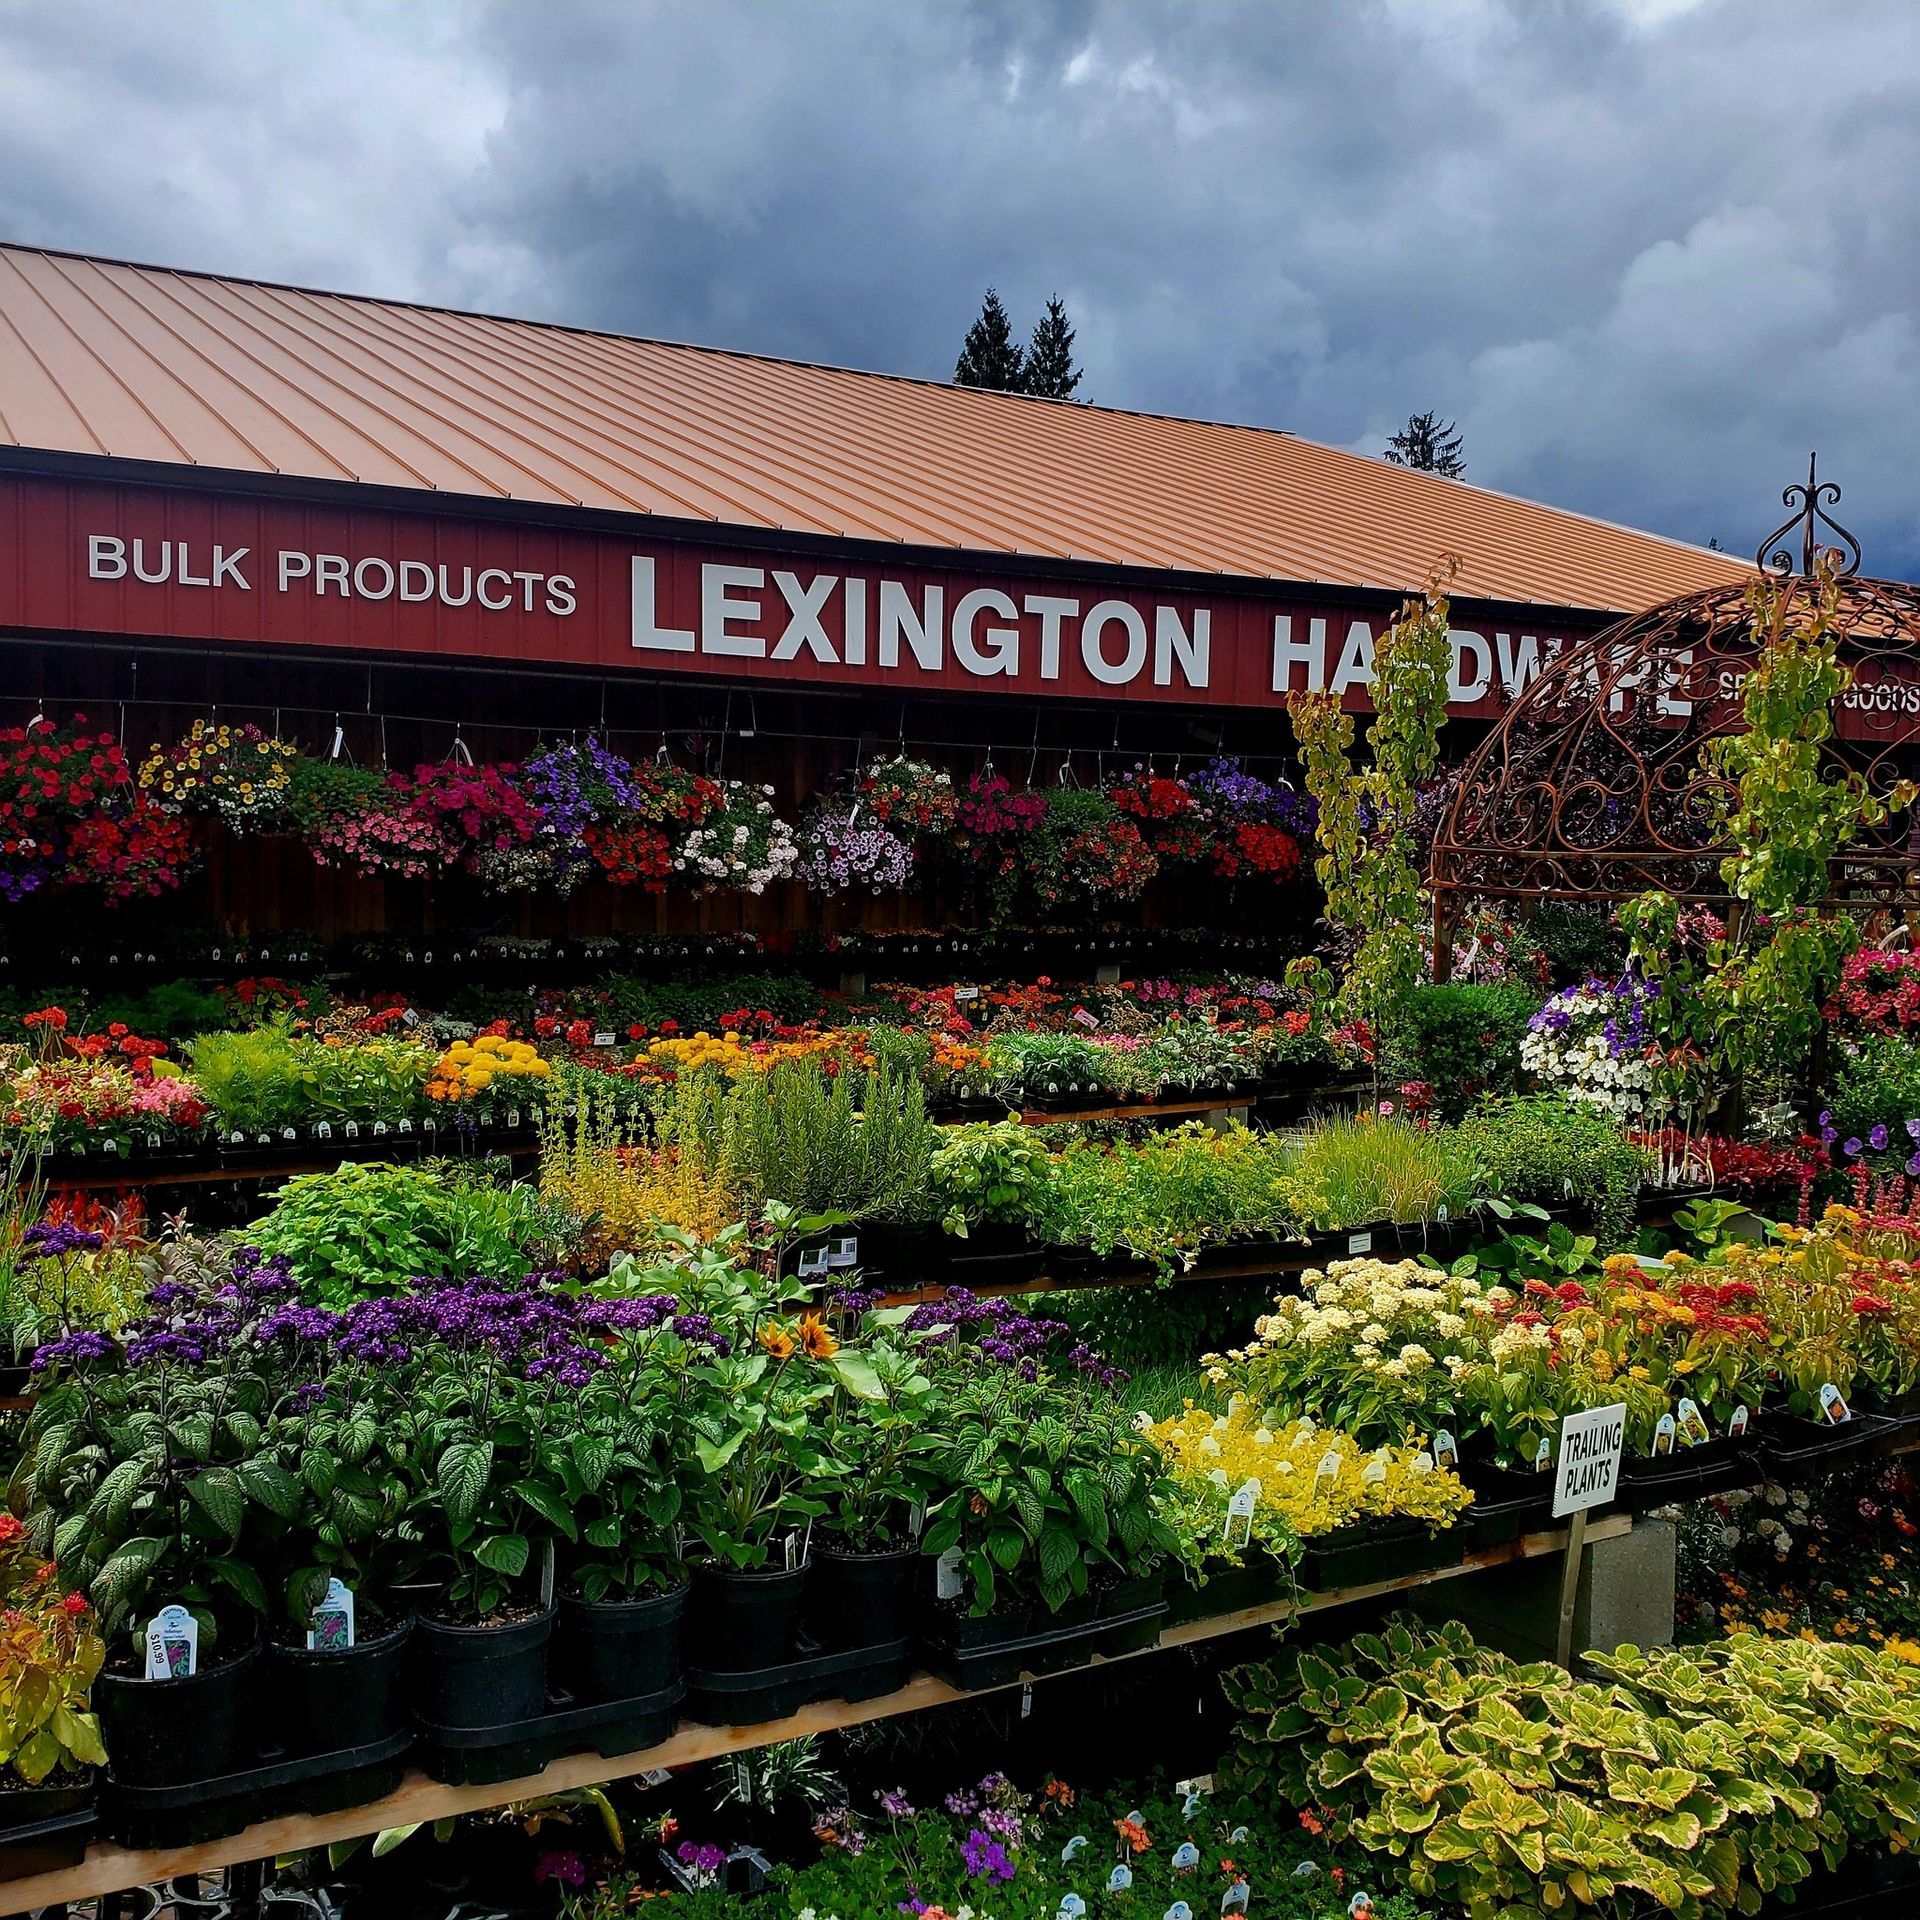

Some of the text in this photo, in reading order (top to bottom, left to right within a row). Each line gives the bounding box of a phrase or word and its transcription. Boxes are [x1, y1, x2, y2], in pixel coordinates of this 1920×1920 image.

[87, 534, 577, 616] BULK PRODUCTS
[630, 555, 1211, 688] LEXINGTON
[1565, 1421, 1622, 1464] TRAILING
[1564, 1458, 1612, 1499] PLANTS
[150, 1633, 165, 1664] $10.99
